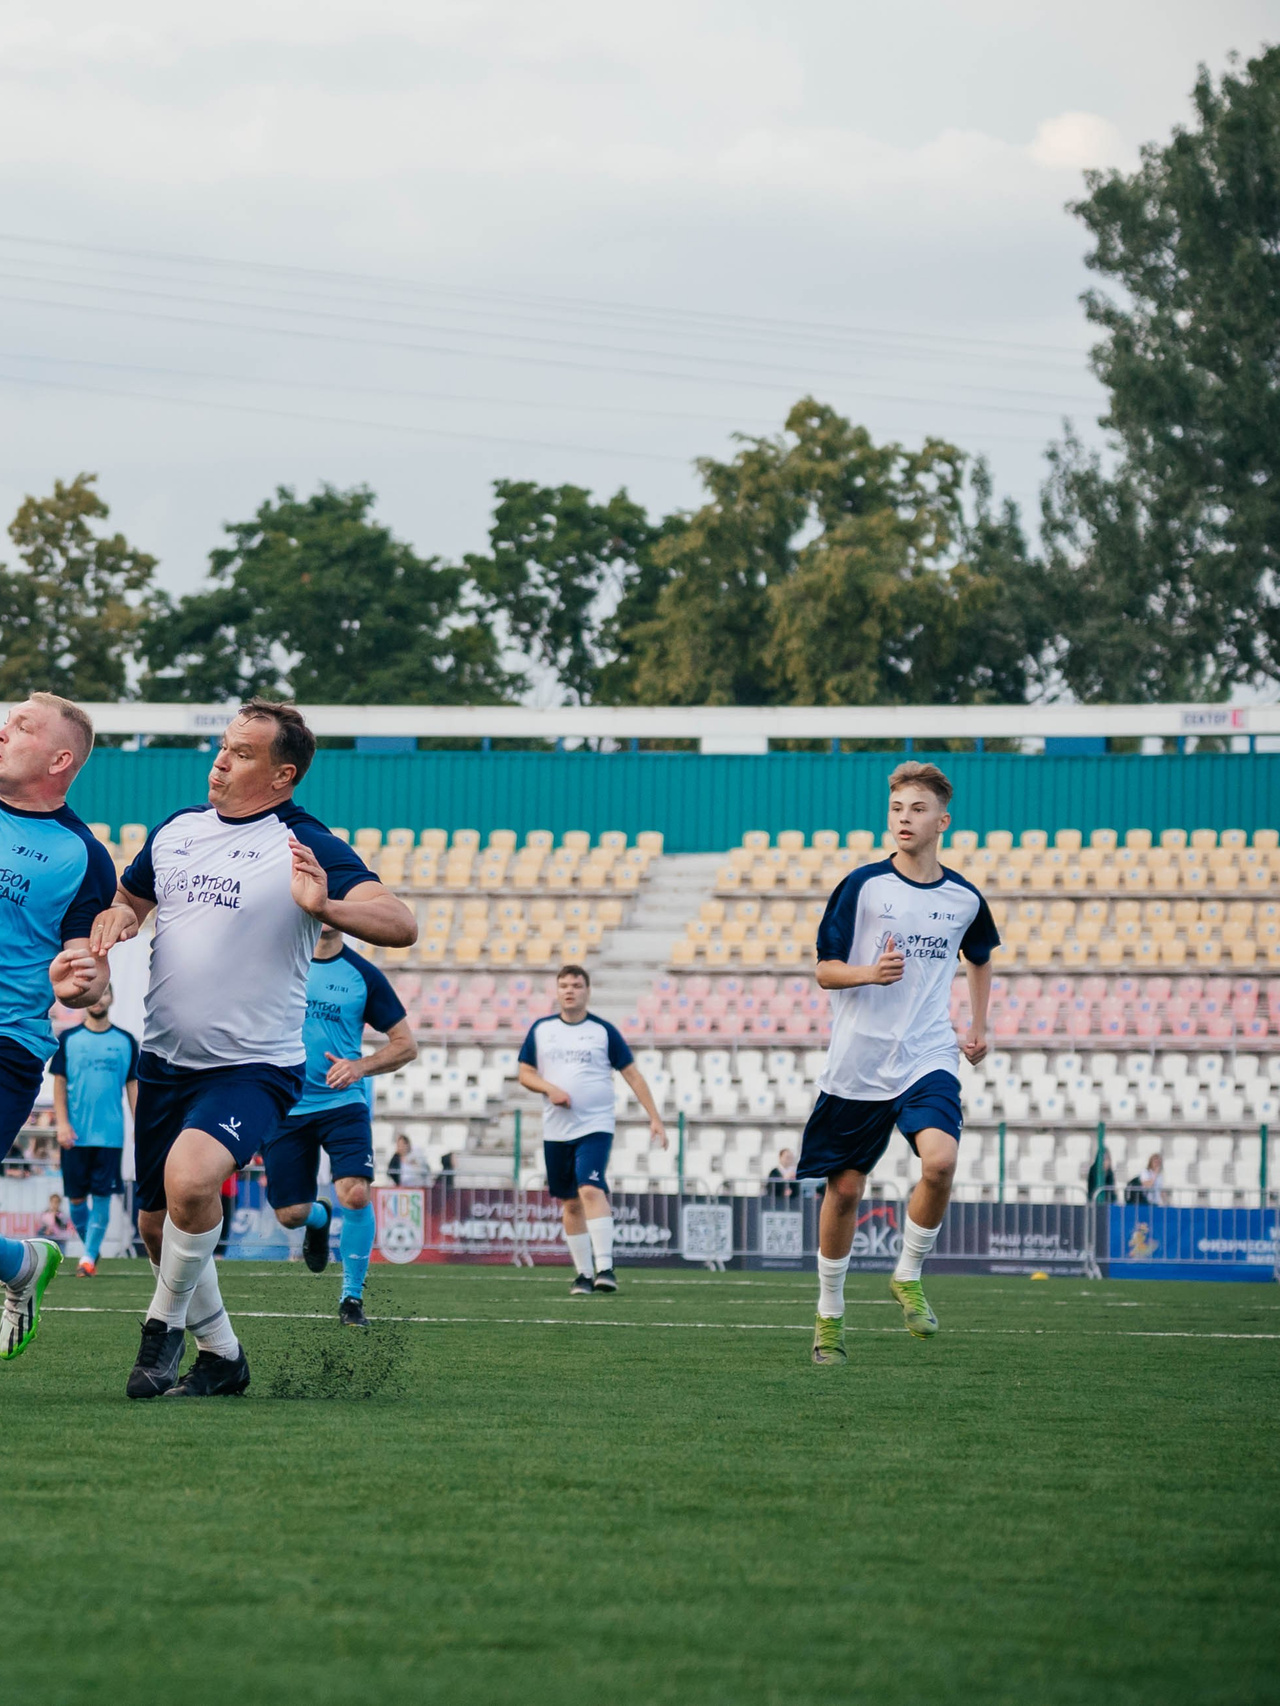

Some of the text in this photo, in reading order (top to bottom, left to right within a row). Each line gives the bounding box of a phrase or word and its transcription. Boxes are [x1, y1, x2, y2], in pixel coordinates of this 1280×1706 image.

[191, 874, 241, 894] ФУТБОЛ
[187, 891, 242, 909] В СЕРДЦЕ
[907, 935, 948, 949] ФУТБОЛ
[906, 949, 947, 959] В СЕРДЦЕ
